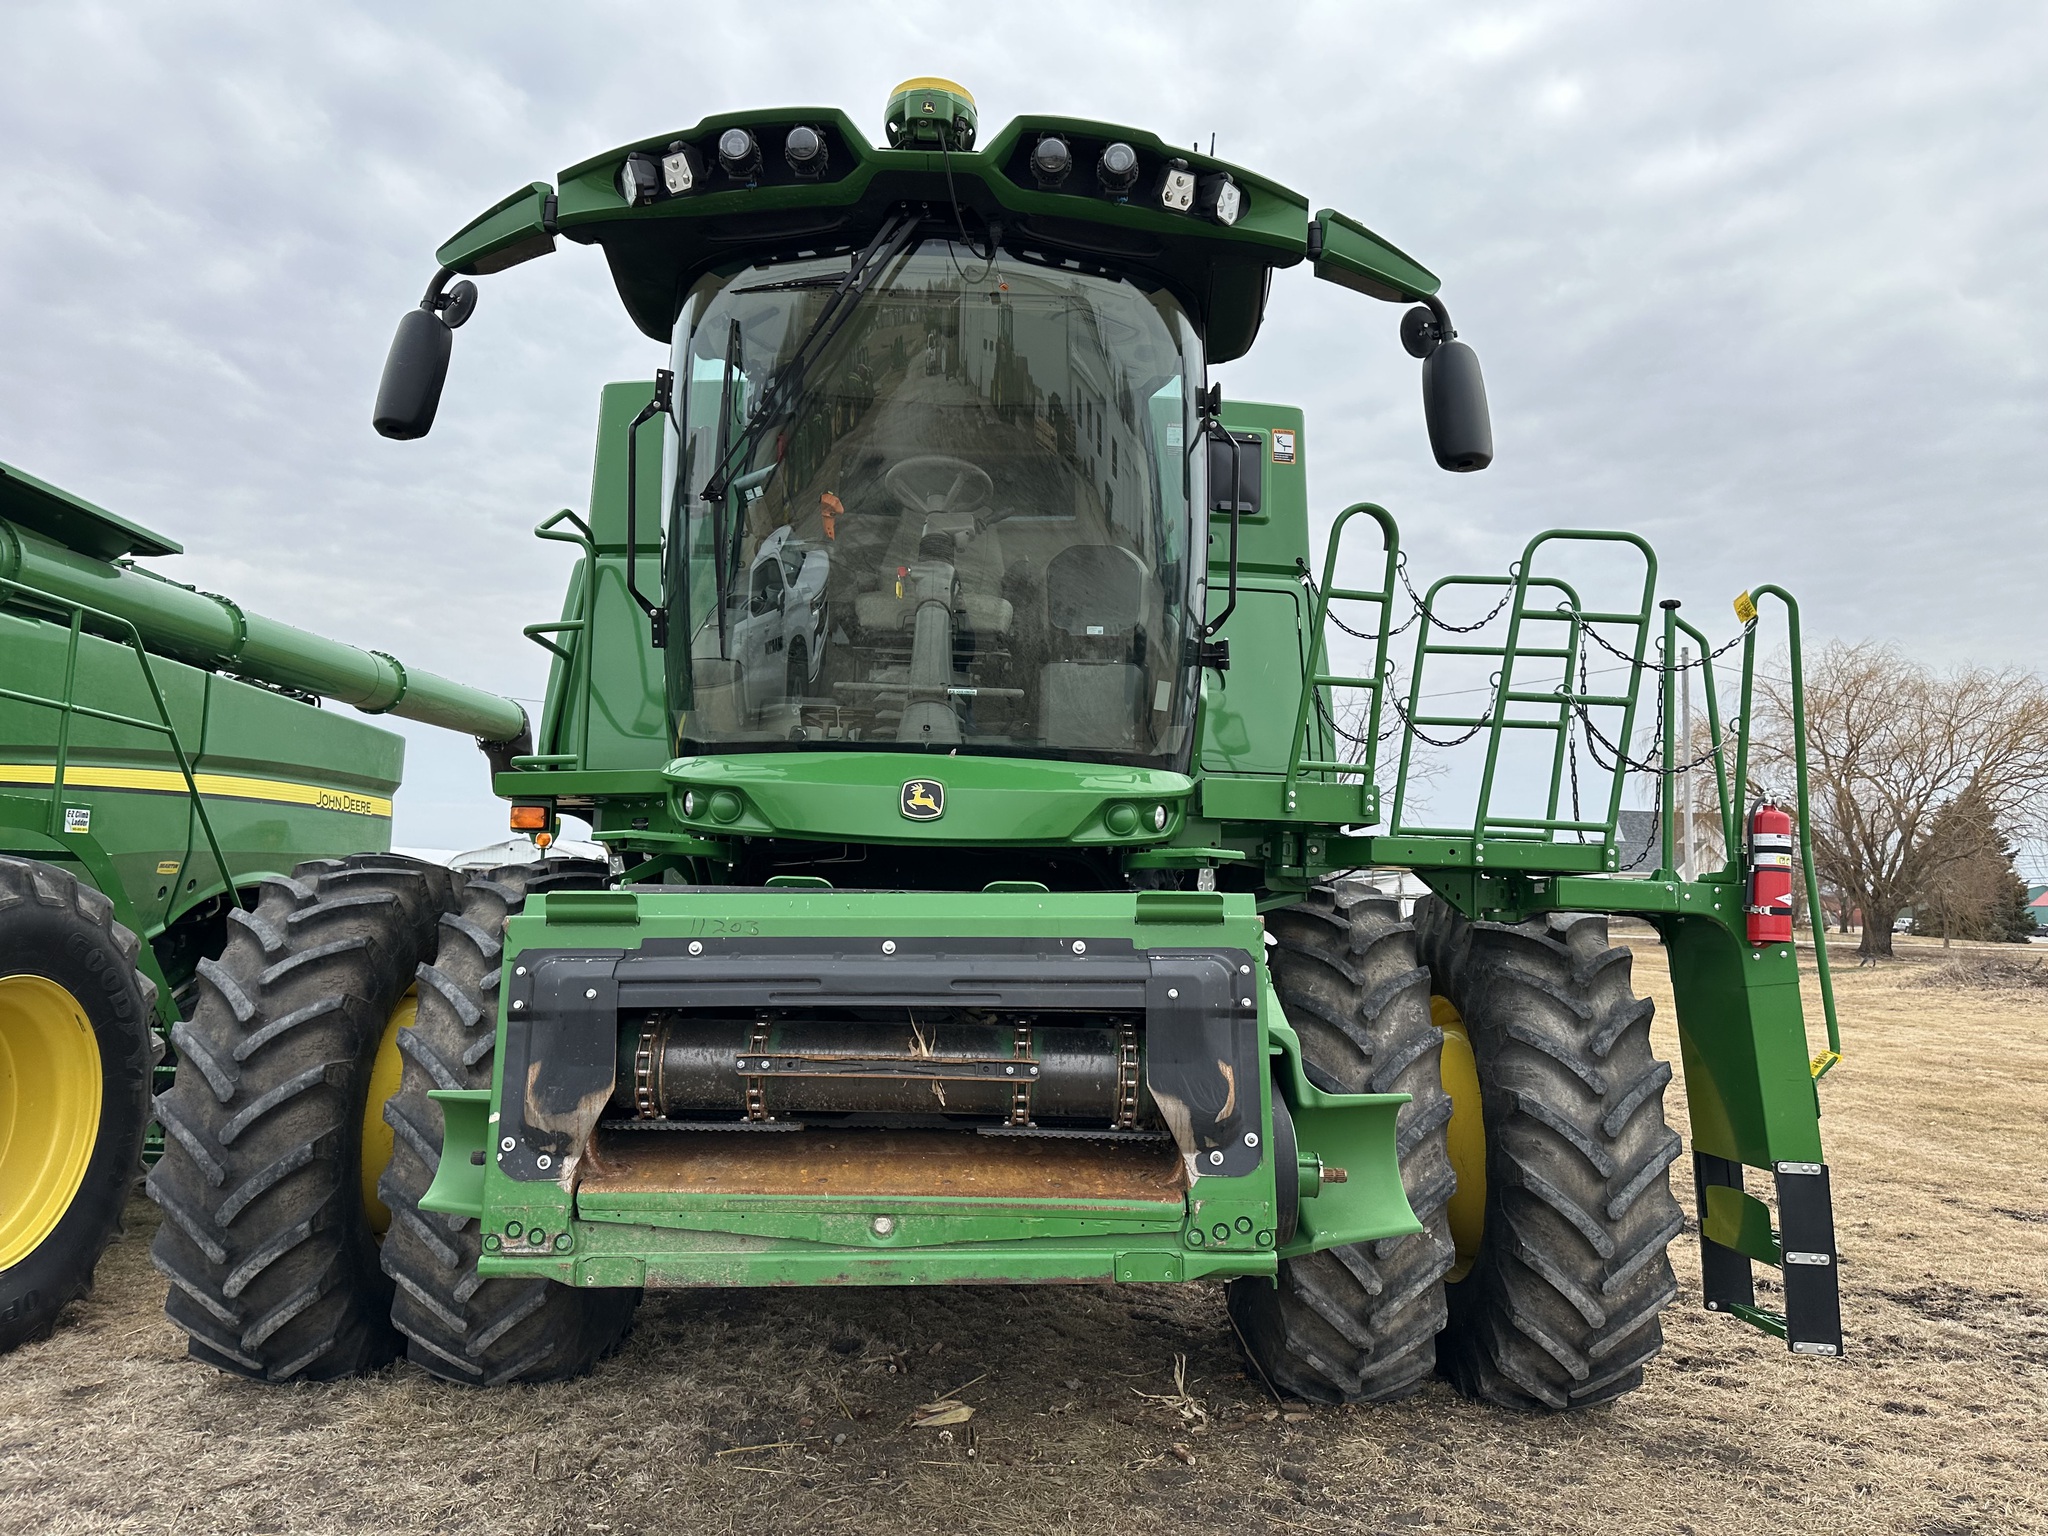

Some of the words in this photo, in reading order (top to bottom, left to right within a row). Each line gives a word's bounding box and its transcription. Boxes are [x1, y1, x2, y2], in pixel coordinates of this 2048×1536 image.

[316, 790, 342, 808] JOHN
[344, 795, 372, 814] DEERE
[72, 818, 88, 826] Ladder
